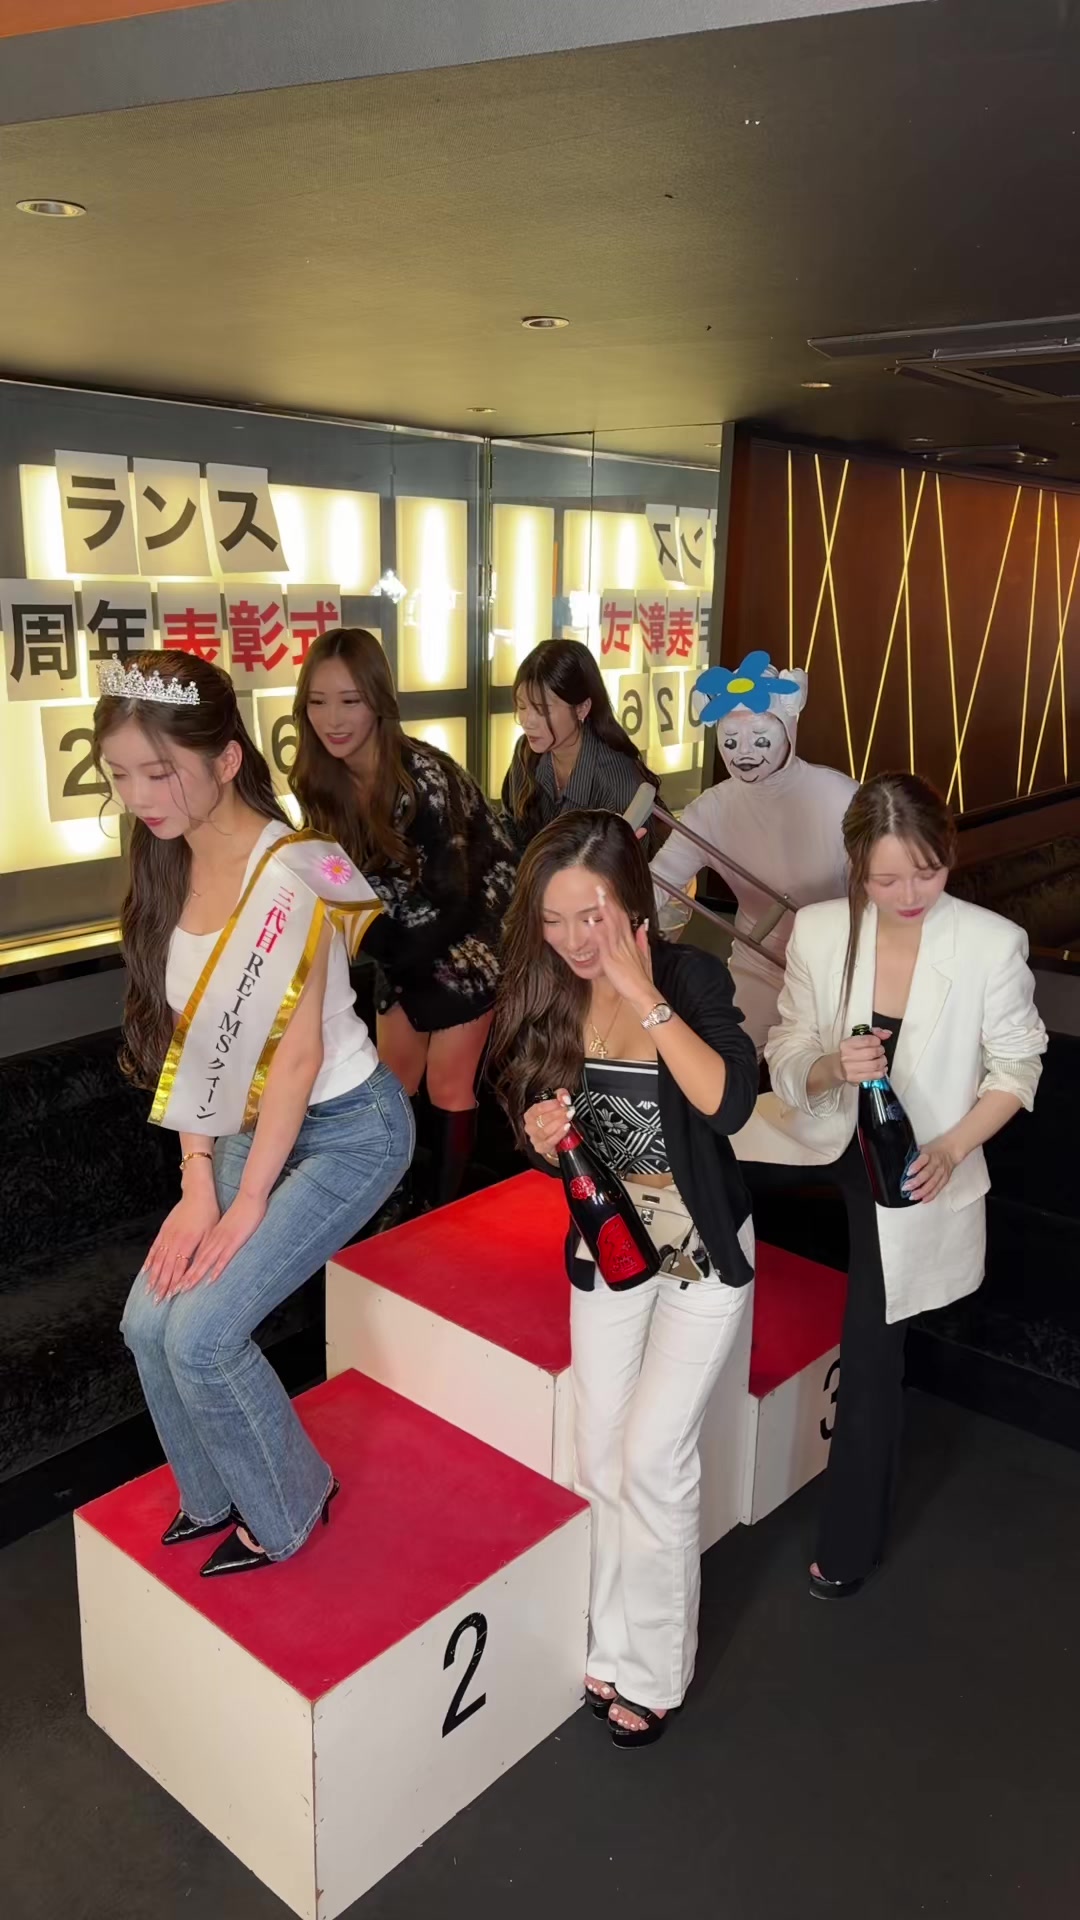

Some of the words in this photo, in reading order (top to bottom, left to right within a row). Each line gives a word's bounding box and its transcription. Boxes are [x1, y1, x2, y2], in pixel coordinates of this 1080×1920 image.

[66, 475, 279, 552] ランス
[442, 1611, 488, 1739] 2
